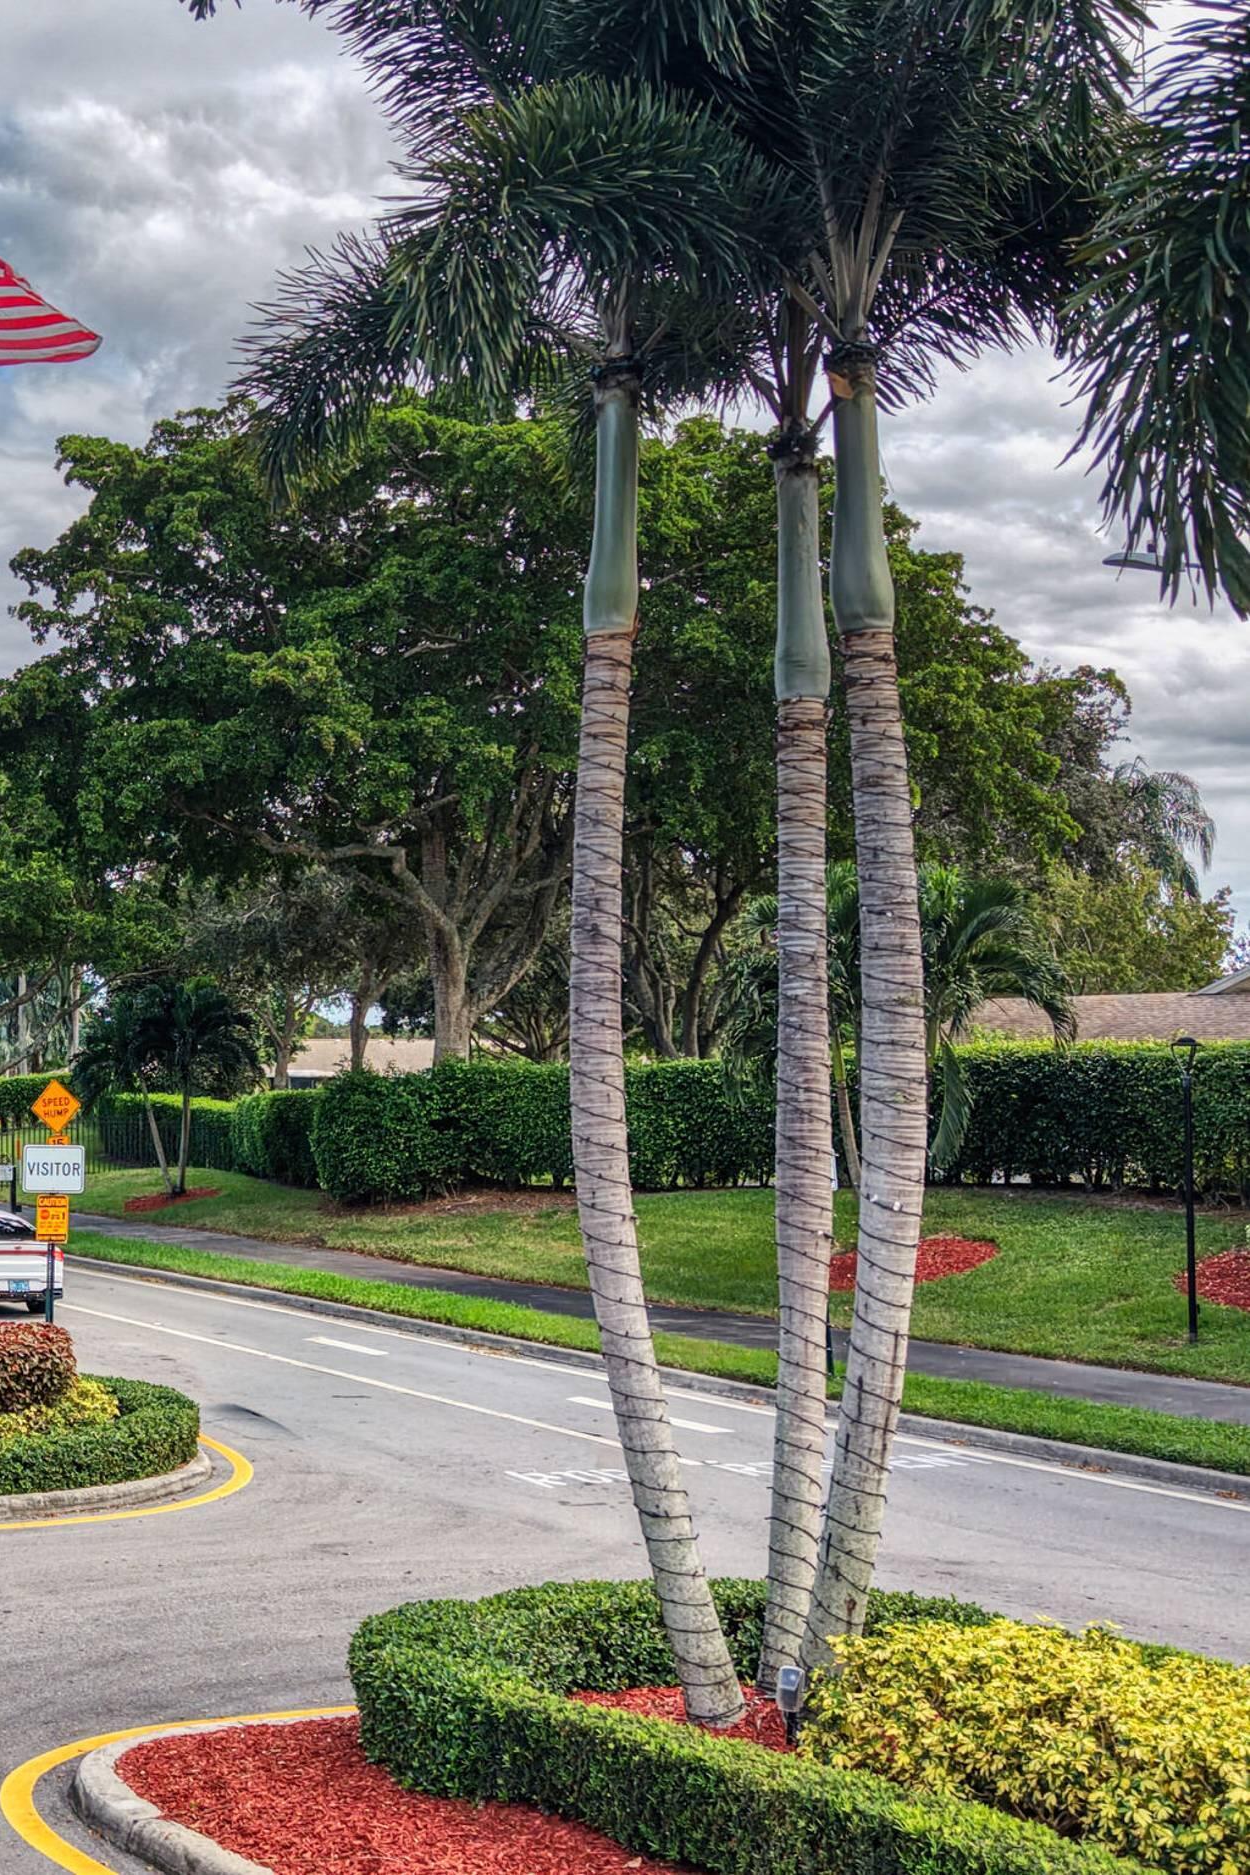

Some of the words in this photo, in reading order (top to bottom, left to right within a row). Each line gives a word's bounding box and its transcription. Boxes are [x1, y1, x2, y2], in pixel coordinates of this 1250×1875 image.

[42, 1097, 70, 1107] SPEED
[43, 1108, 69, 1118] HUMP
[27, 1162, 80, 1176] VISITOR
